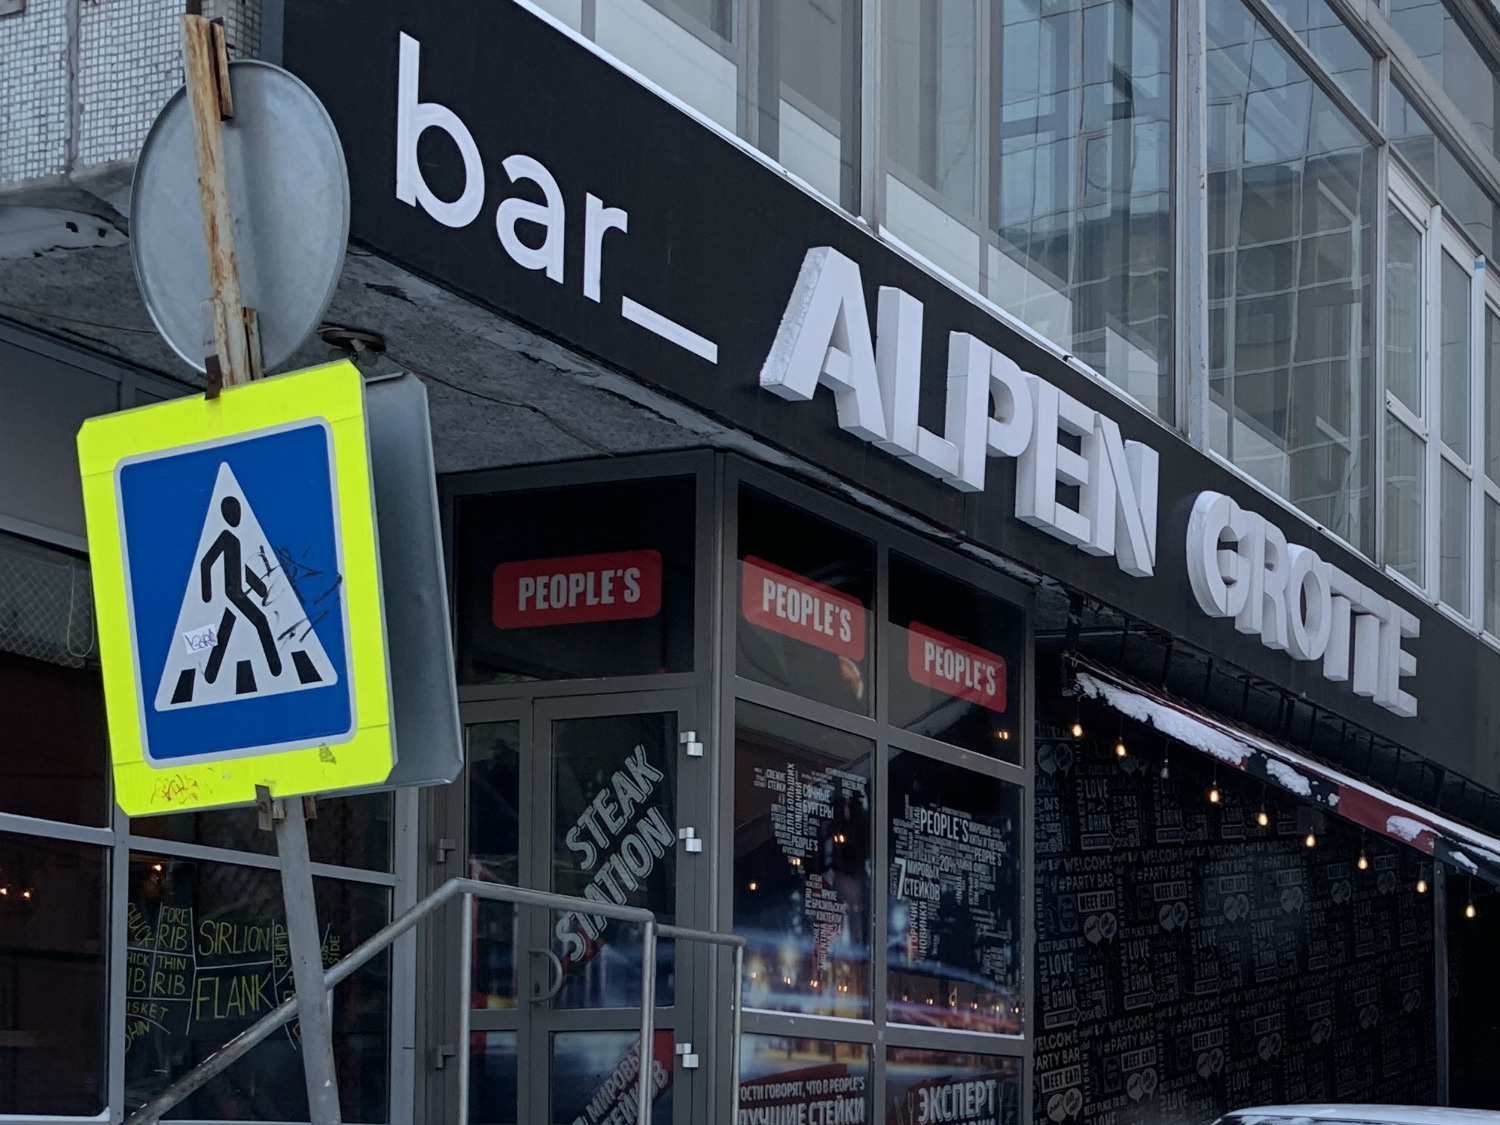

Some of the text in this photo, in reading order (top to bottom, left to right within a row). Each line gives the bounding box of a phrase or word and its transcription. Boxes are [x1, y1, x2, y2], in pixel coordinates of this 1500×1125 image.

[759, 246, 1420, 717] ALPEN GROTTE
[518, 567, 641, 611] PEOPLE'S
[763, 577, 852, 643] PEOPLE'S
[924, 640, 997, 696] PEOPLE'S
[565, 744, 664, 870] STEAK
[787, 762, 795, 833] ДЛЯ БОЛЬШИХ
[803, 800, 834, 819] БУРГЕРЫ
[920, 809, 969, 843] PEOPLE'S
[791, 835, 818, 852] PEOPLE'S
[974, 847, 1002, 867] PEOPLE'S
[1063, 857, 1112, 873] WELCOME
[1141, 848, 1184, 864] WELCOME
[907, 859, 939, 879] МИРОВЫХ
[556, 806, 676, 962] STATION
[904, 876, 940, 900] СТЕЙКОВ
[1058, 873, 1114, 892] #PARTY BAR
[162, 906, 189, 926] FORE
[910, 900, 918, 949] ГОРЯЧИЕ
[919, 901, 927, 953] НОВИНКИ
[159, 924, 188, 951] RIB
[199, 920, 270, 956] SIRLION
[127, 953, 150, 967] HICK
[1128, 939, 1151, 960] LOVE
[158, 955, 186, 970] THIN
[1049, 952, 1075, 975] LOVE
[128, 968, 146, 993] IB
[153, 972, 186, 995] RIB
[196, 973, 274, 1021] FLANK
[1180, 997, 1221, 1014] WELCOME
[1109, 1013, 1154, 1034] WELCOME
[1104, 1030, 1155, 1053] #PARTY BAR
[1062, 1047, 1080, 1063] BAR
[740, 1085, 764, 1101] ОСТИ
[806, 1080, 821, 1095] ЧТО
[823, 1079, 829, 1094] В
[829, 1075, 865, 1093] PEOPLE'S
[1167, 1088, 1189, 1111] LOVE
[918, 1079, 997, 1125] ЭКСПЕРТ
